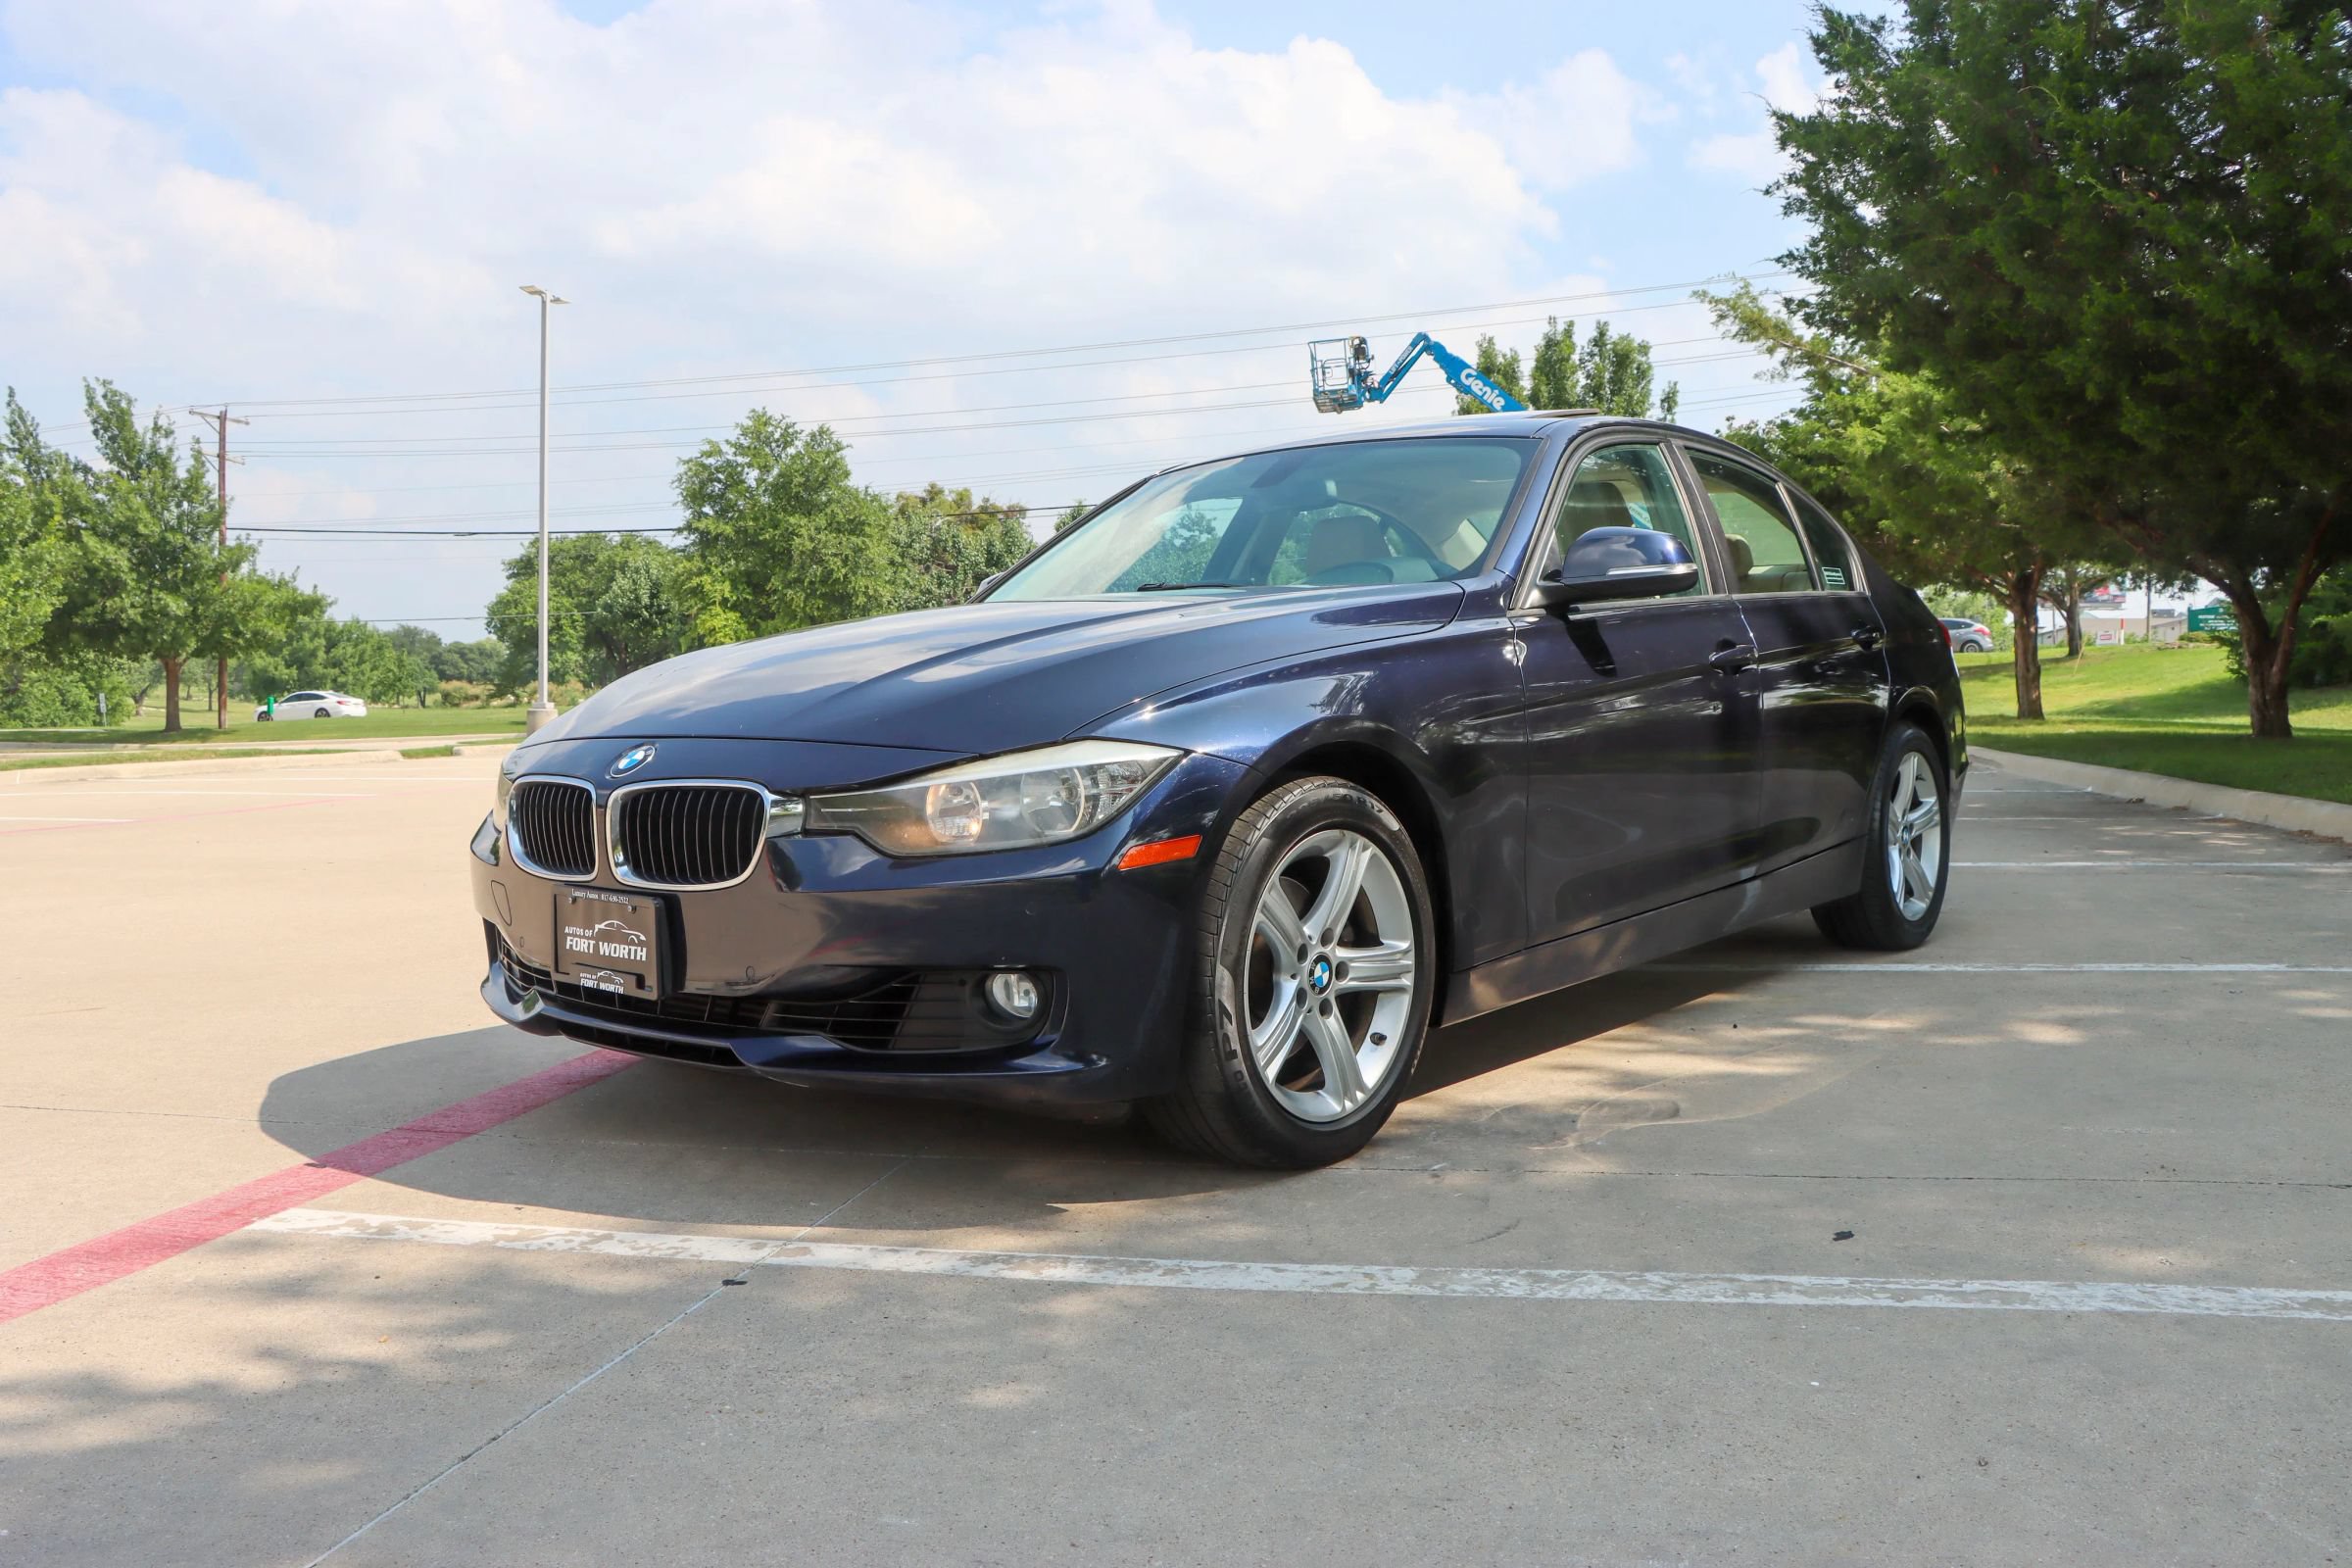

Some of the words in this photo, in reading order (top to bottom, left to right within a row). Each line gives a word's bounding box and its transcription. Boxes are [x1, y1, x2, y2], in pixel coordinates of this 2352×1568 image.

[1460, 368, 1505, 411] Genie
[571, 888, 586, 900] Luxury
[564, 925, 584, 937] AUTOS
[584, 929, 593, 938] OF
[565, 936, 596, 954] FORT
[599, 941, 647, 961] WORTH
[580, 978, 598, 989] FORT
[599, 982, 624, 995] WORTH
[1217, 998, 1239, 1060] P7
